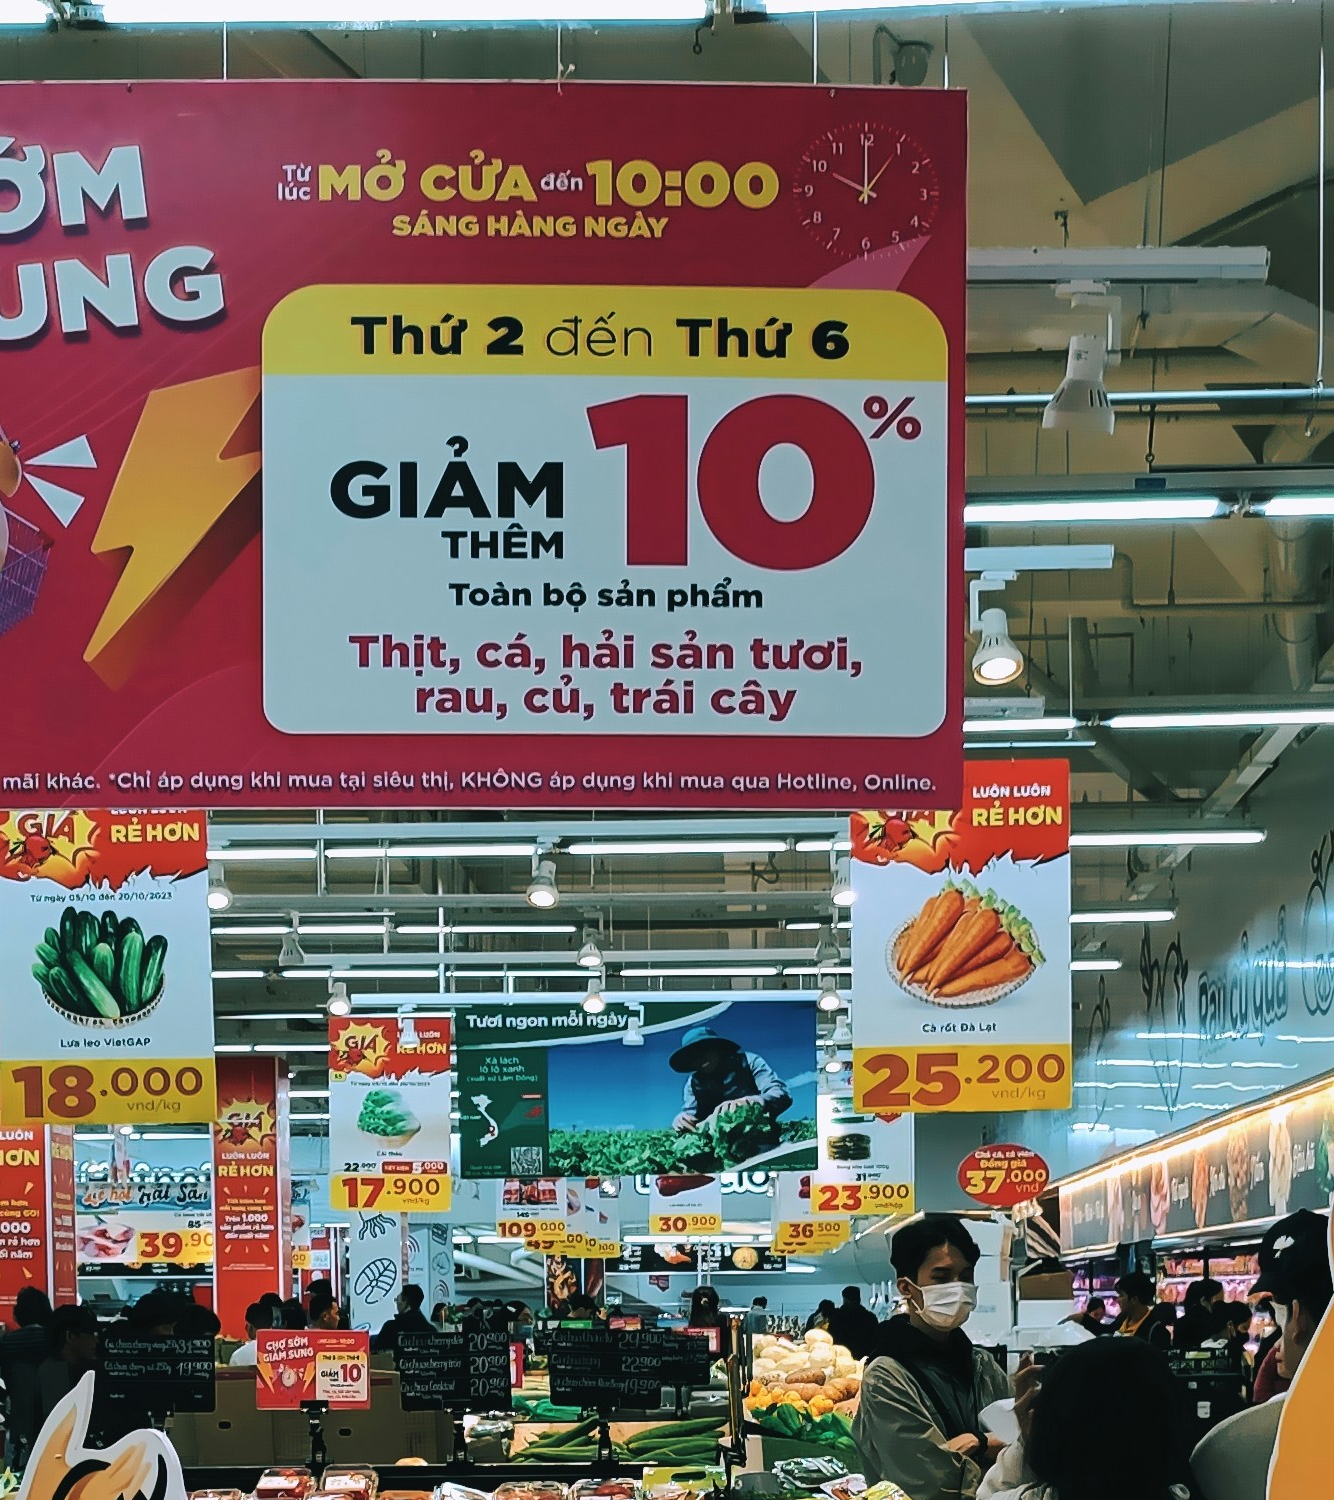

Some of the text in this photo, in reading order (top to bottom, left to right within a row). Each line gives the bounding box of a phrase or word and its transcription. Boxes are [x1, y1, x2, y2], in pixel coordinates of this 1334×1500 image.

[317, 148, 780, 210] MỞ CỬA đến 10:00
[391, 209, 670, 239] SÁNG HÀNG NGÀY
[349, 311, 851, 360] Thứ 2 đến Thứ 6
[328, 433, 565, 519] GIẢM
[440, 522, 565, 560] THÊM
[447, 576, 764, 613] Toàn bộ sản phẩm
[348, 628, 864, 677] Thịt, cá, hải sản tươi,
[414, 674, 798, 722] rau, củ, trái cây
[2, 771, 41, 791] mãi
[190, 767, 937, 794] dụng khi mua tại siêu KHÔNG dụng khi mua qua Hotline, Online.
[971, 783, 1052, 799] LUÔN LUÔN
[971, 799, 1064, 828] RẺ HƠN
[110, 817, 201, 844] RẺ HƠN
[465, 1012, 628, 1033] Tươi ngon ngày
[921, 1020, 998, 1035] Cà rốt Đà Lạt
[11, 1064, 204, 1119] 18.000
[861, 1052, 1066, 1108] 25.200
[991, 1086, 1047, 1101] vnd/kg
[126, 1098, 182, 1112] vnd/kg
[341, 1176, 441, 1208] 17.900
[965, 1168, 1047, 1195] 37.000
[818, 1184, 910, 1212] 23.900
